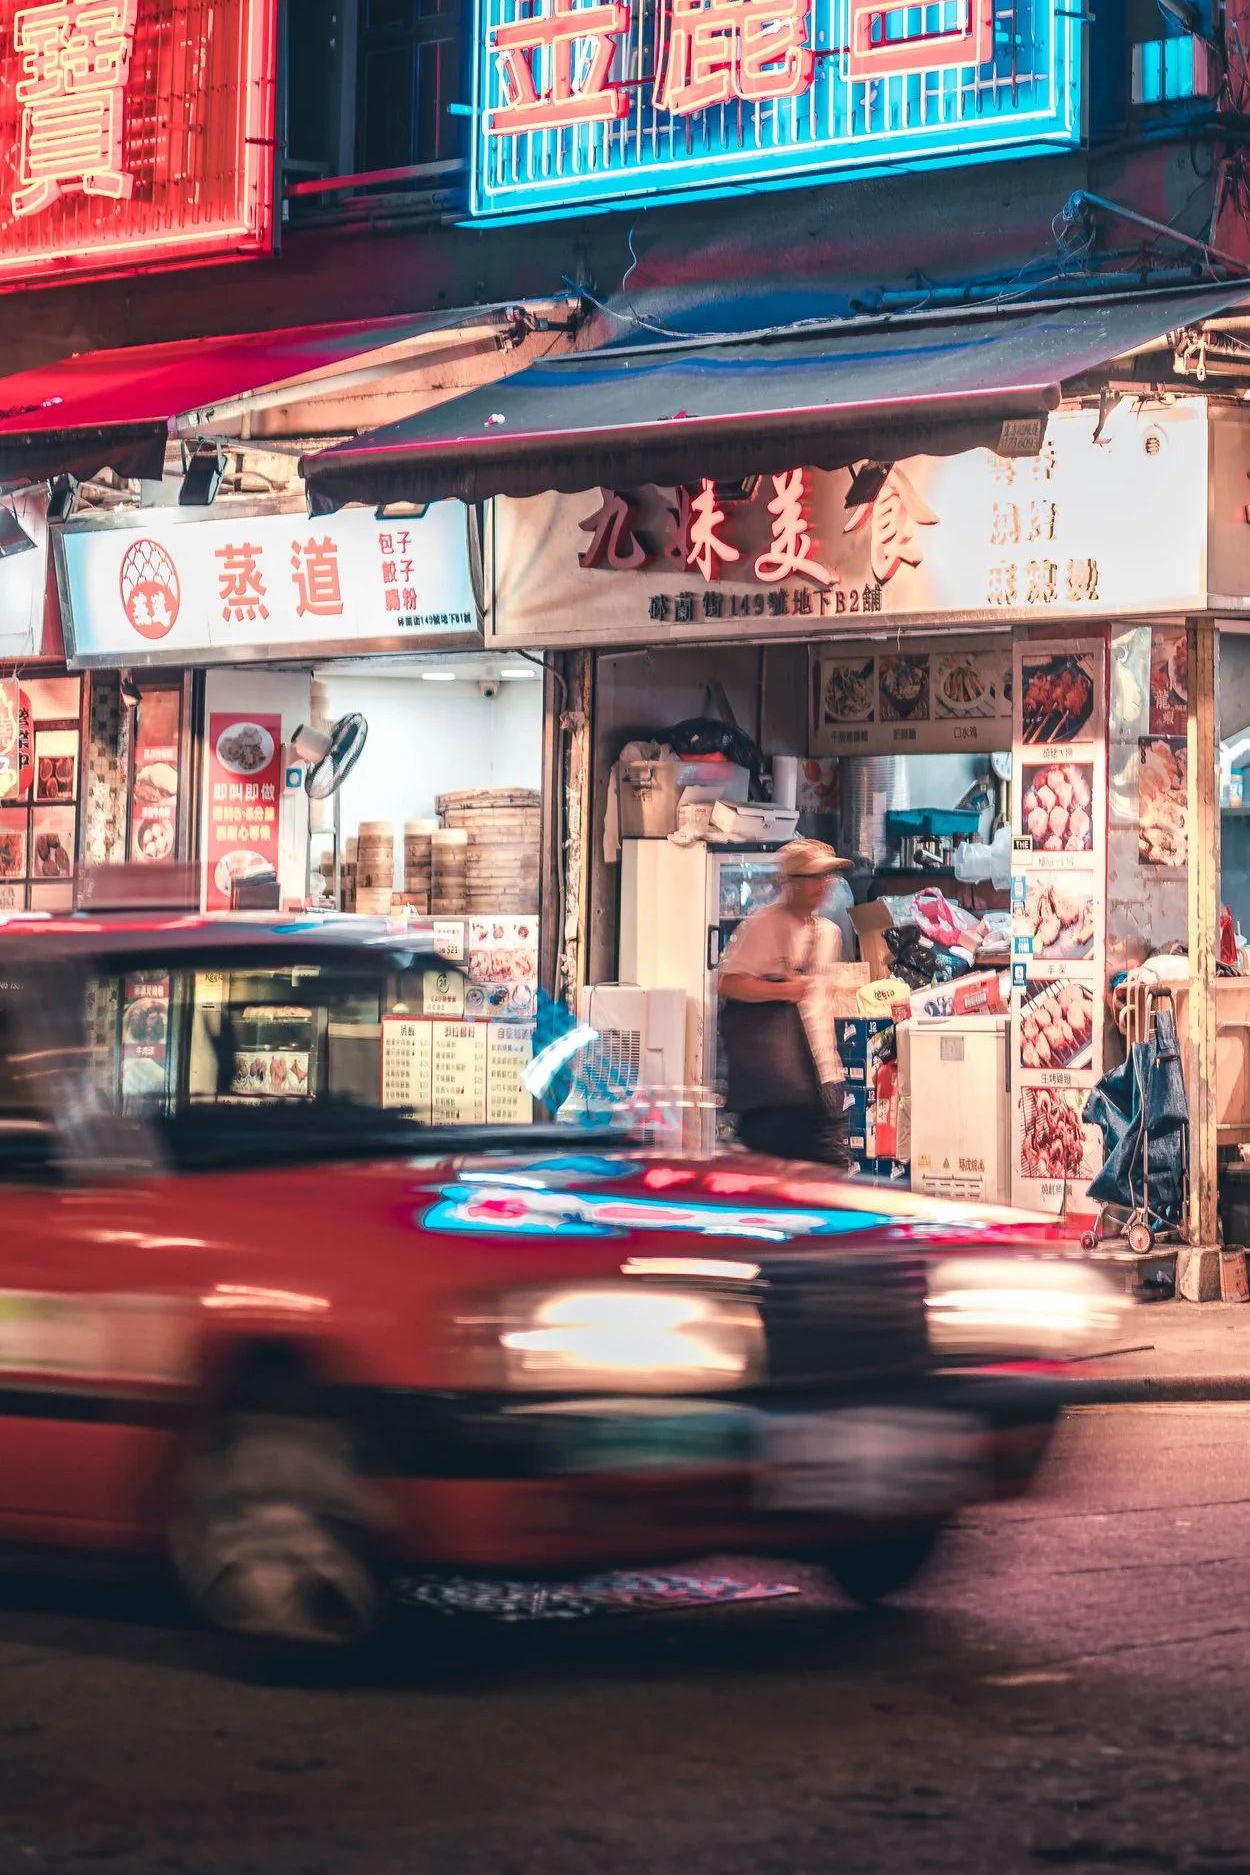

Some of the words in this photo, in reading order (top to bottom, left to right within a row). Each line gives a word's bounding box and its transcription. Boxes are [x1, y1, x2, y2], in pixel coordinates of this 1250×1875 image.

[379, 531, 411, 554] 包子
[214, 535, 344, 623] 蒸道
[1015, 840, 1029, 850] THE
